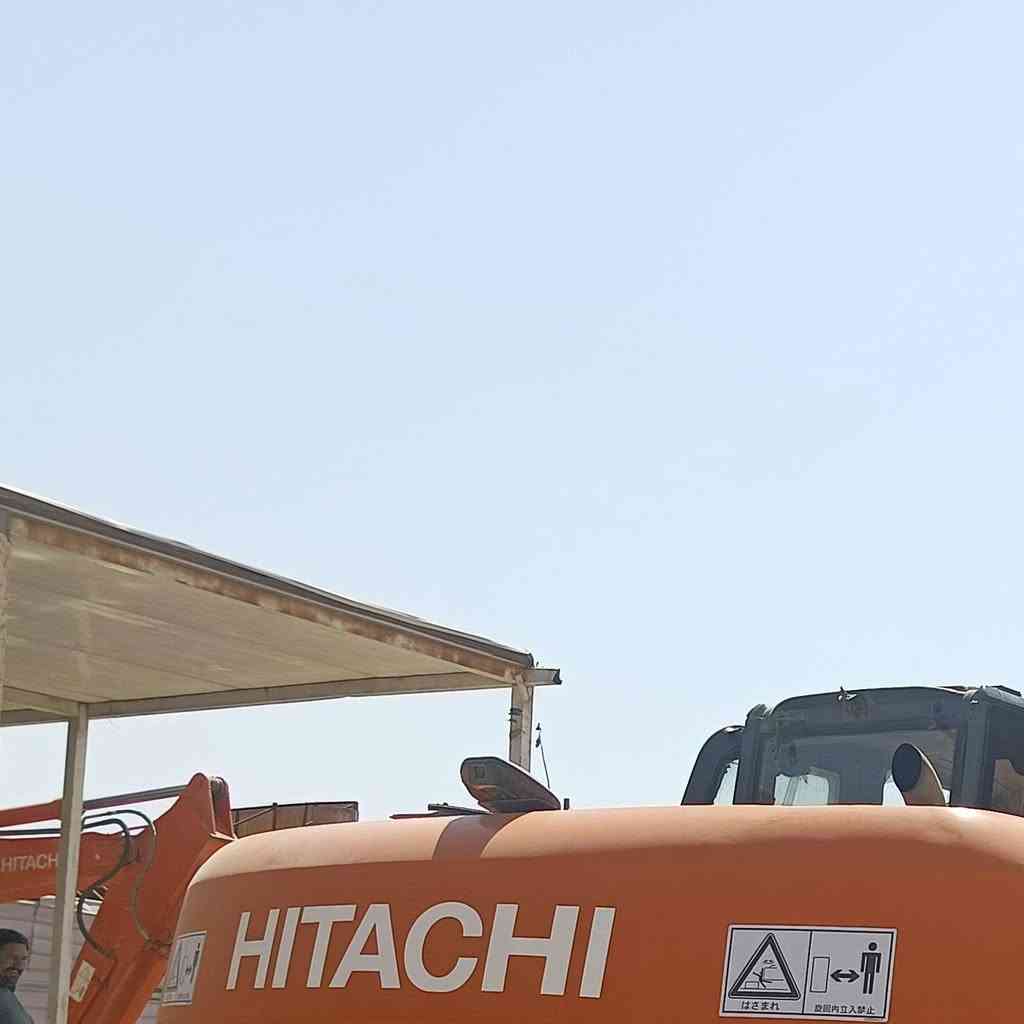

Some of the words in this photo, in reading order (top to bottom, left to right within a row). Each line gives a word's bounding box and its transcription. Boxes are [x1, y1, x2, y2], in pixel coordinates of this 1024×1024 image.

[1, 853, 58, 873] HITACH
[226, 902, 616, 998] HITACHI
[740, 1001, 780, 1011] はさまれ
